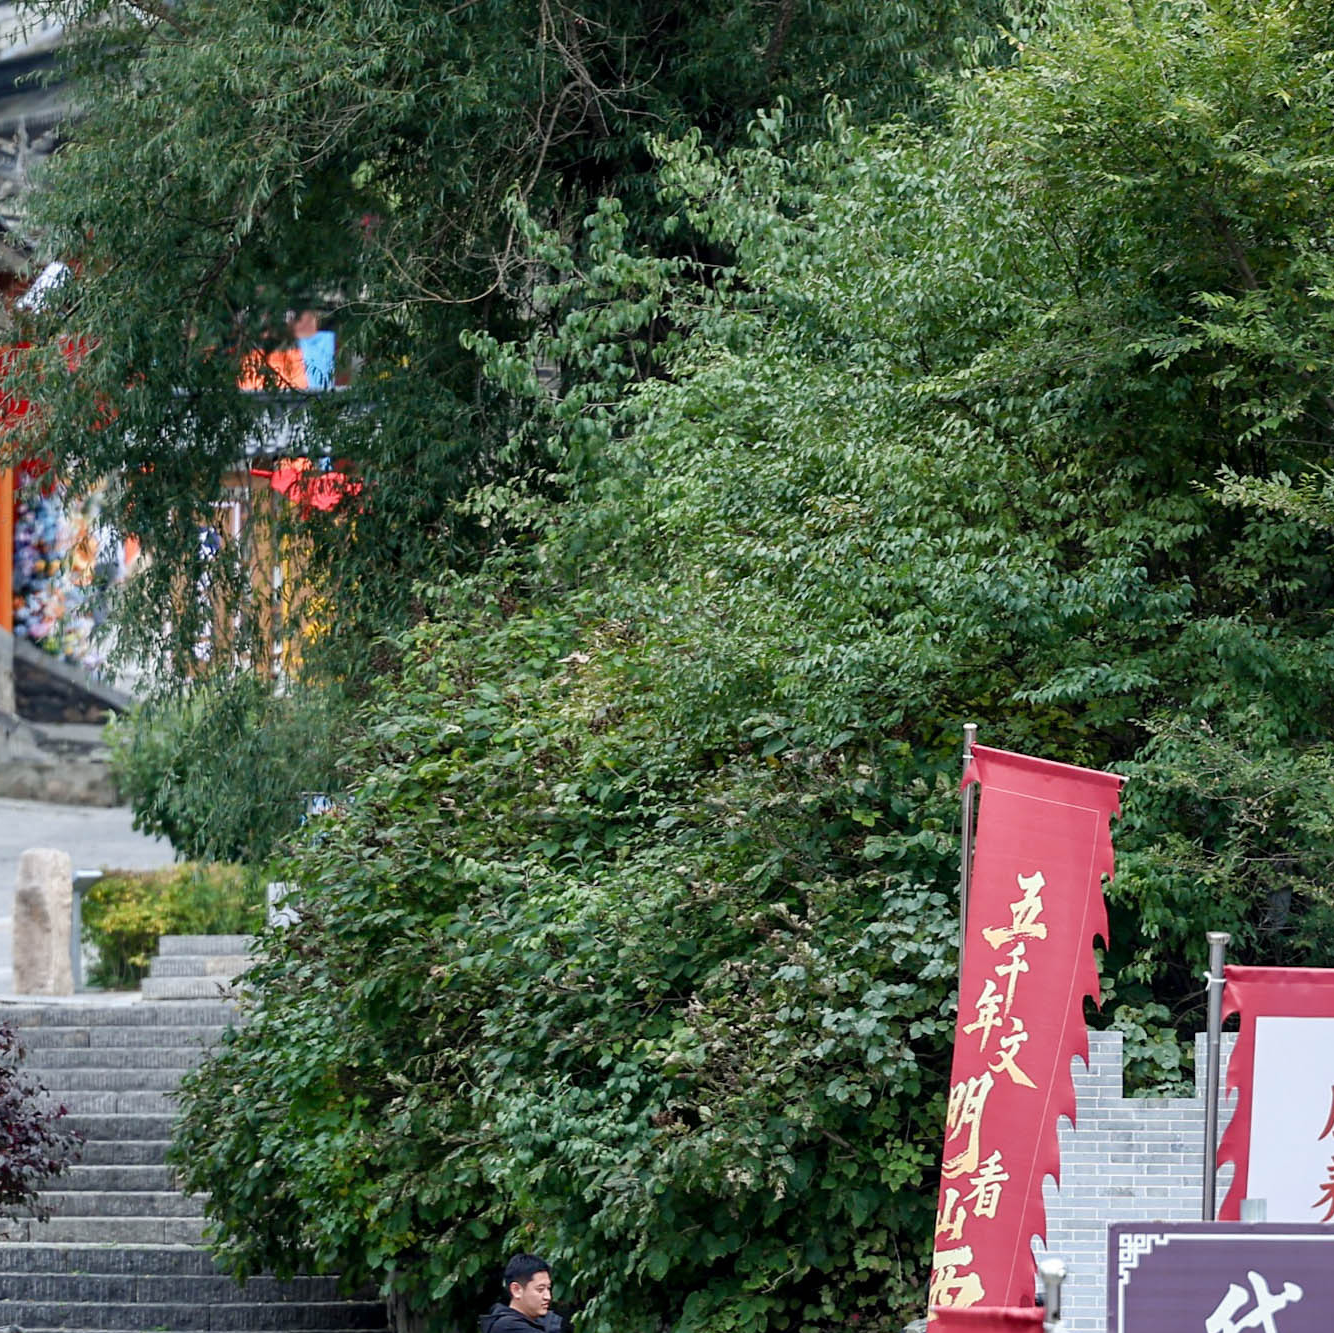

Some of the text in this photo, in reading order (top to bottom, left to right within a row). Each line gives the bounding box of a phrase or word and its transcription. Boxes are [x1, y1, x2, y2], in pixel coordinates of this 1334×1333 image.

[927, 870, 1048, 1320] 五千年文明看山西
